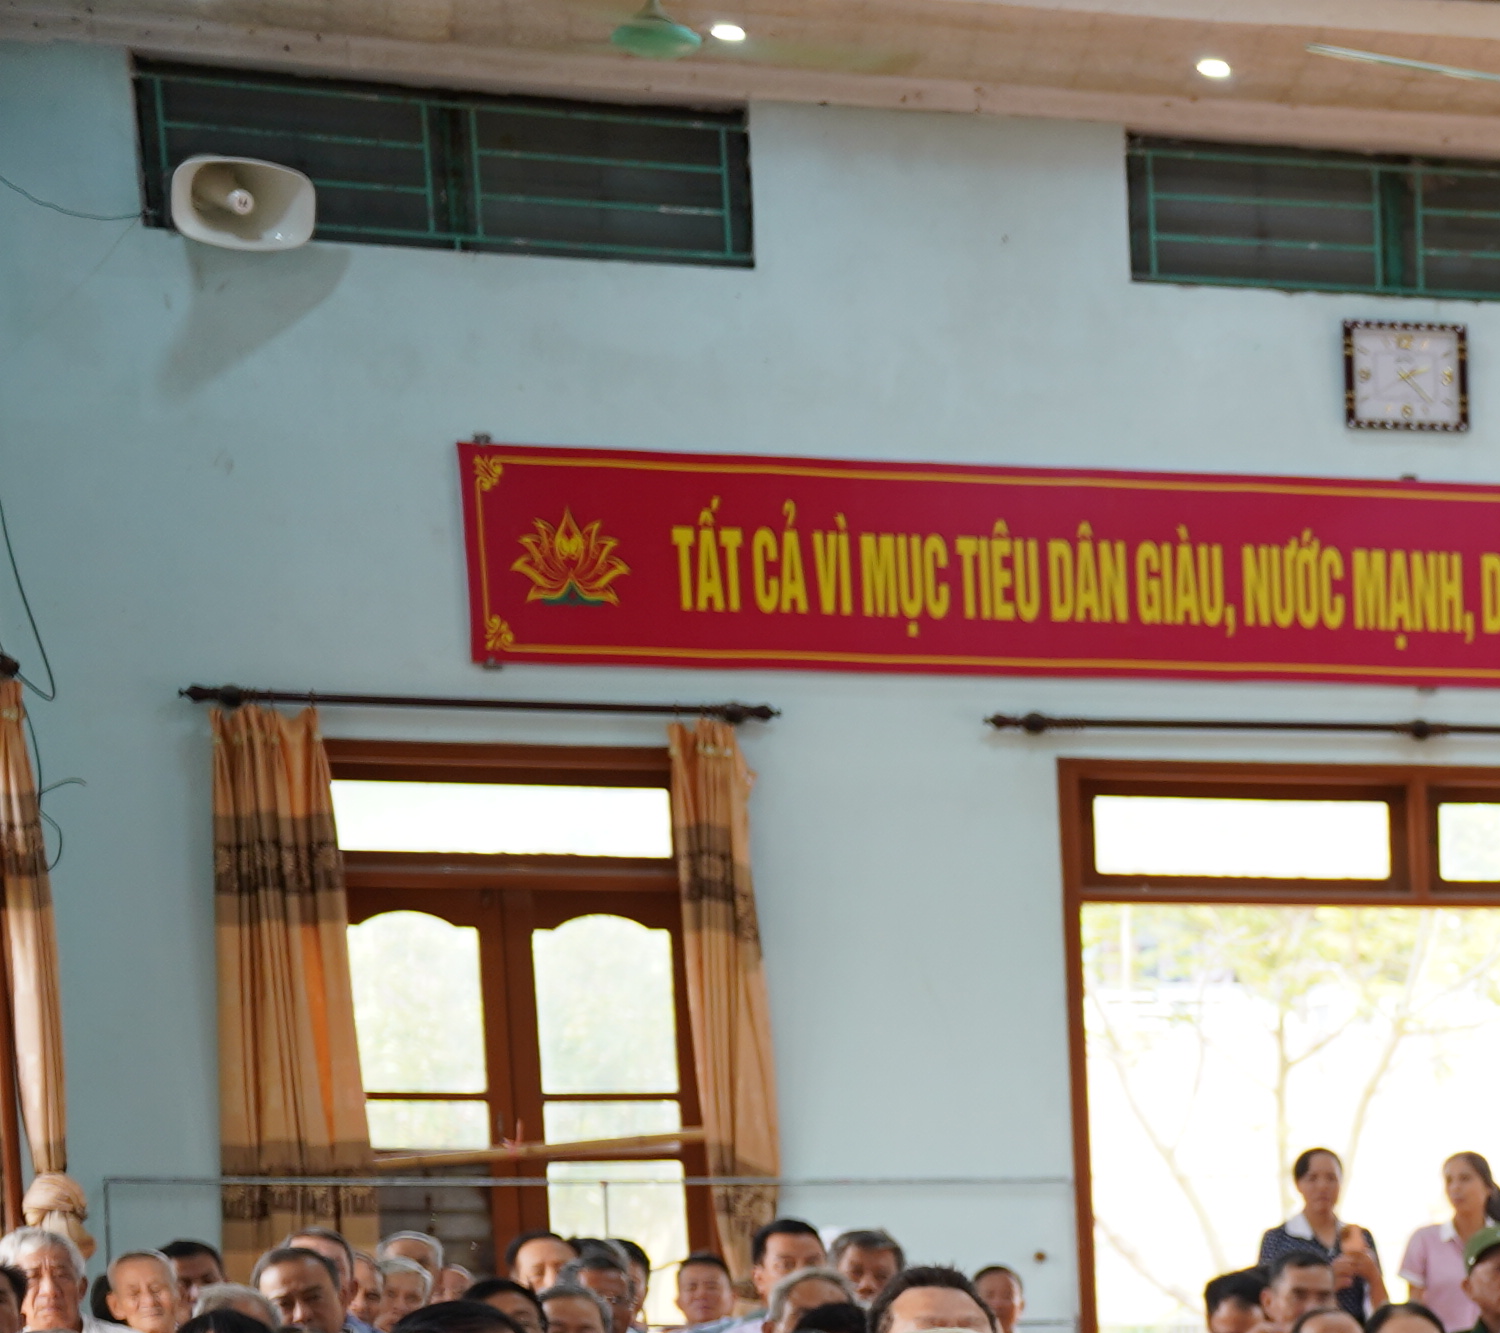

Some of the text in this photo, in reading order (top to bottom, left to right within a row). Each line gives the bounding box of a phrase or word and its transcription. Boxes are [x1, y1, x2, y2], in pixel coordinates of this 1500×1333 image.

[670, 496, 743, 612] TẤT
[752, 499, 809, 614] CẢ
[812, 513, 853, 616] VÌ
[859, 532, 950, 638] MỤC
[955, 518, 1041, 623] TIÊU
[1047, 520, 1129, 624] DÂN
[1135, 524, 1236, 637] GIÀU,
[1241, 528, 1345, 630] NƯỚC
[1351, 547, 1475, 651] MẠNH,
